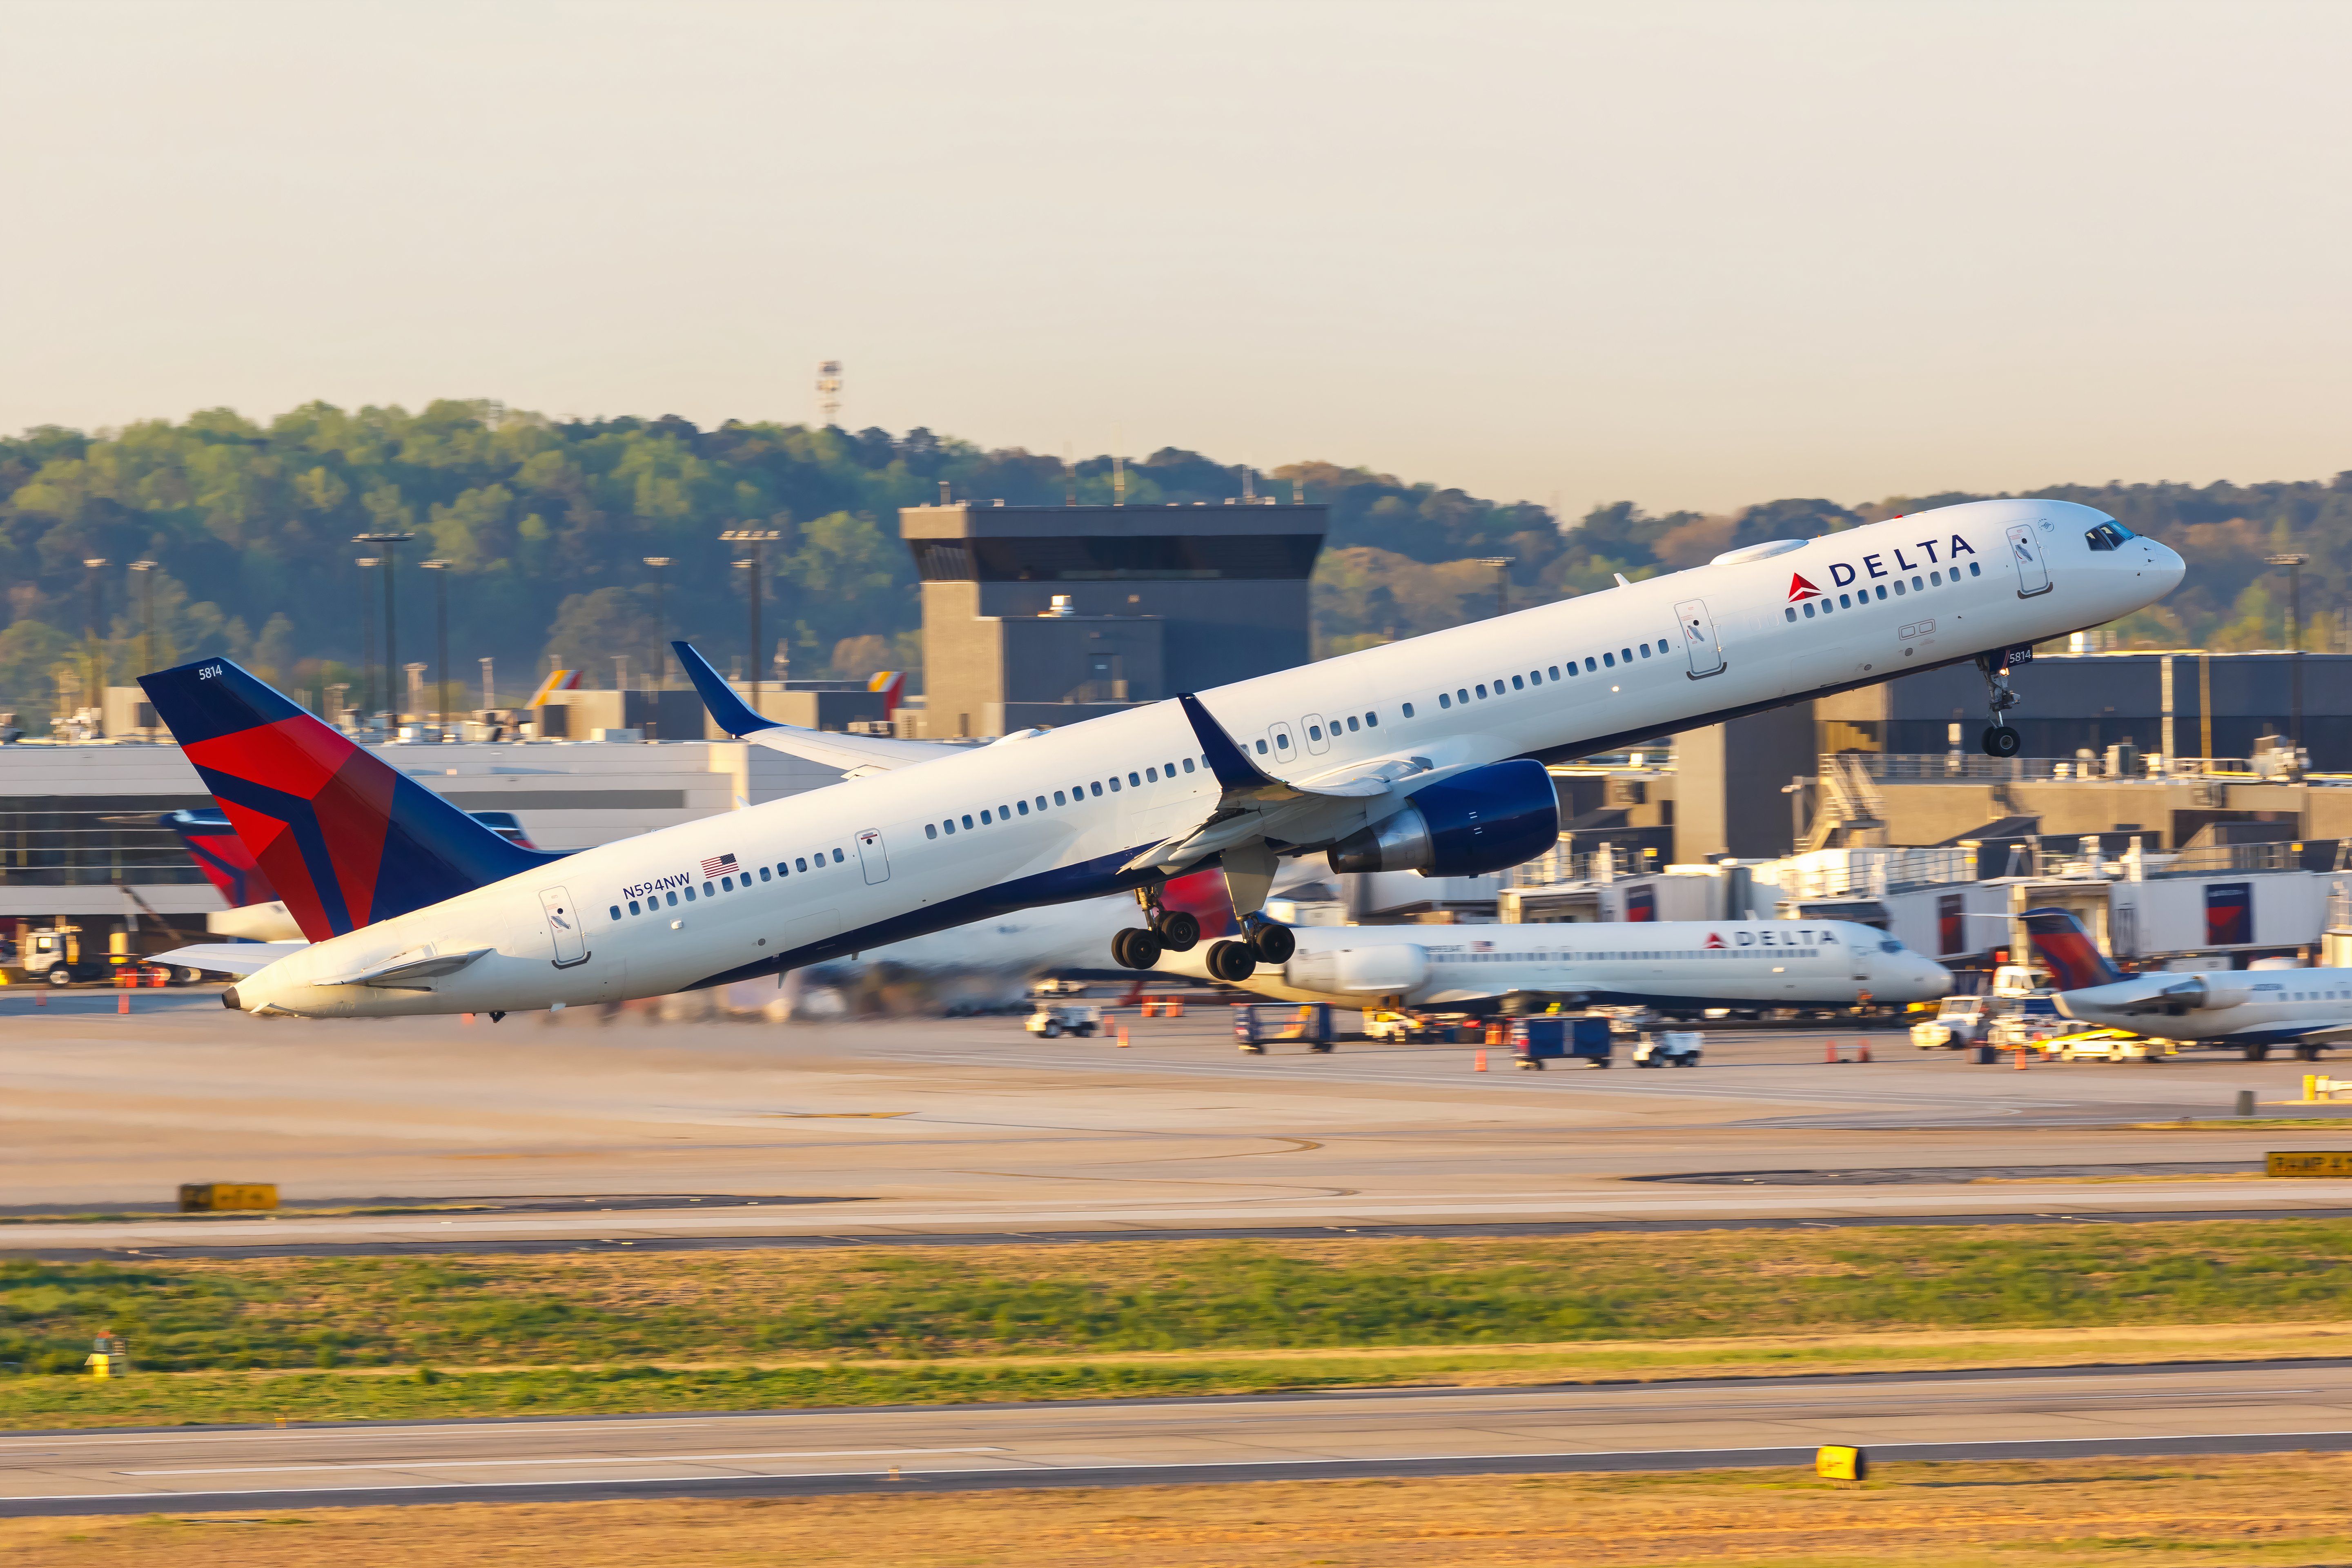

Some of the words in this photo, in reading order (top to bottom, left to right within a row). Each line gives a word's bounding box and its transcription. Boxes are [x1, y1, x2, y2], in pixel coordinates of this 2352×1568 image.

[1829, 534, 1976, 588] DELTA
[2009, 650, 2031, 664] 5814
[198, 664, 223, 680] 5814
[622, 872, 690, 900] N594NW
[1734, 930, 1841, 947] DELTA
